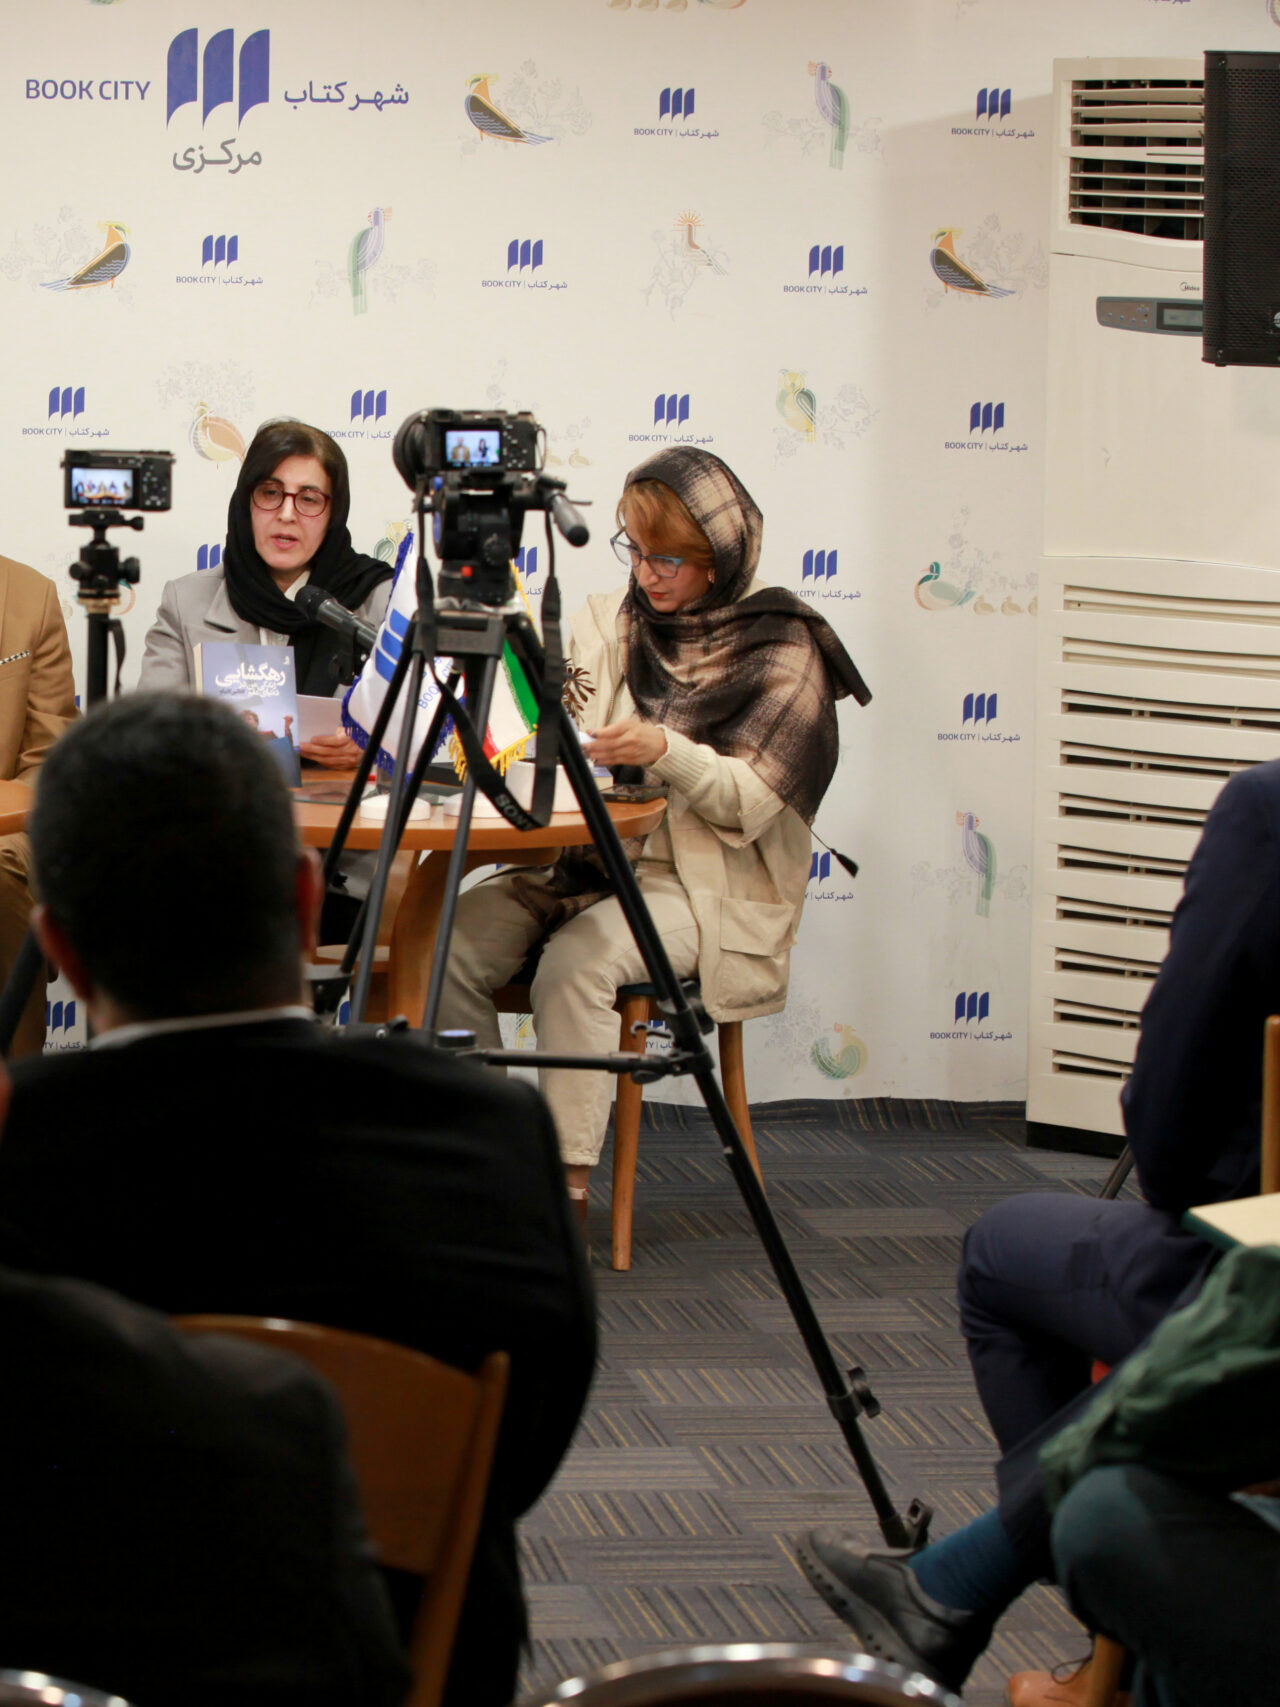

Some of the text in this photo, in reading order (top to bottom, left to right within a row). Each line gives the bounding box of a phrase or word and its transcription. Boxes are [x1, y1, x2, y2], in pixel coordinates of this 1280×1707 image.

[25, 79, 151, 100] BOOK CITY
[283, 80, 410, 112] شهر کتاب
[634, 128, 673, 136] BOOK CITY
[973, 128, 990, 136] CITY
[172, 138, 263, 174] مرکزی
[176, 276, 216, 284] BOOK CITY
[482, 280, 522, 288] BOOK CITY
[783, 285, 823, 293] BOOK CITY
[22, 428, 63, 436] BOOK CITY
[628, 434, 668, 442] BOOK CITY
[944, 442, 984, 450] BOOK CITY
[799, 590, 816, 598] CITY
[959, 733, 976, 741] CITY
